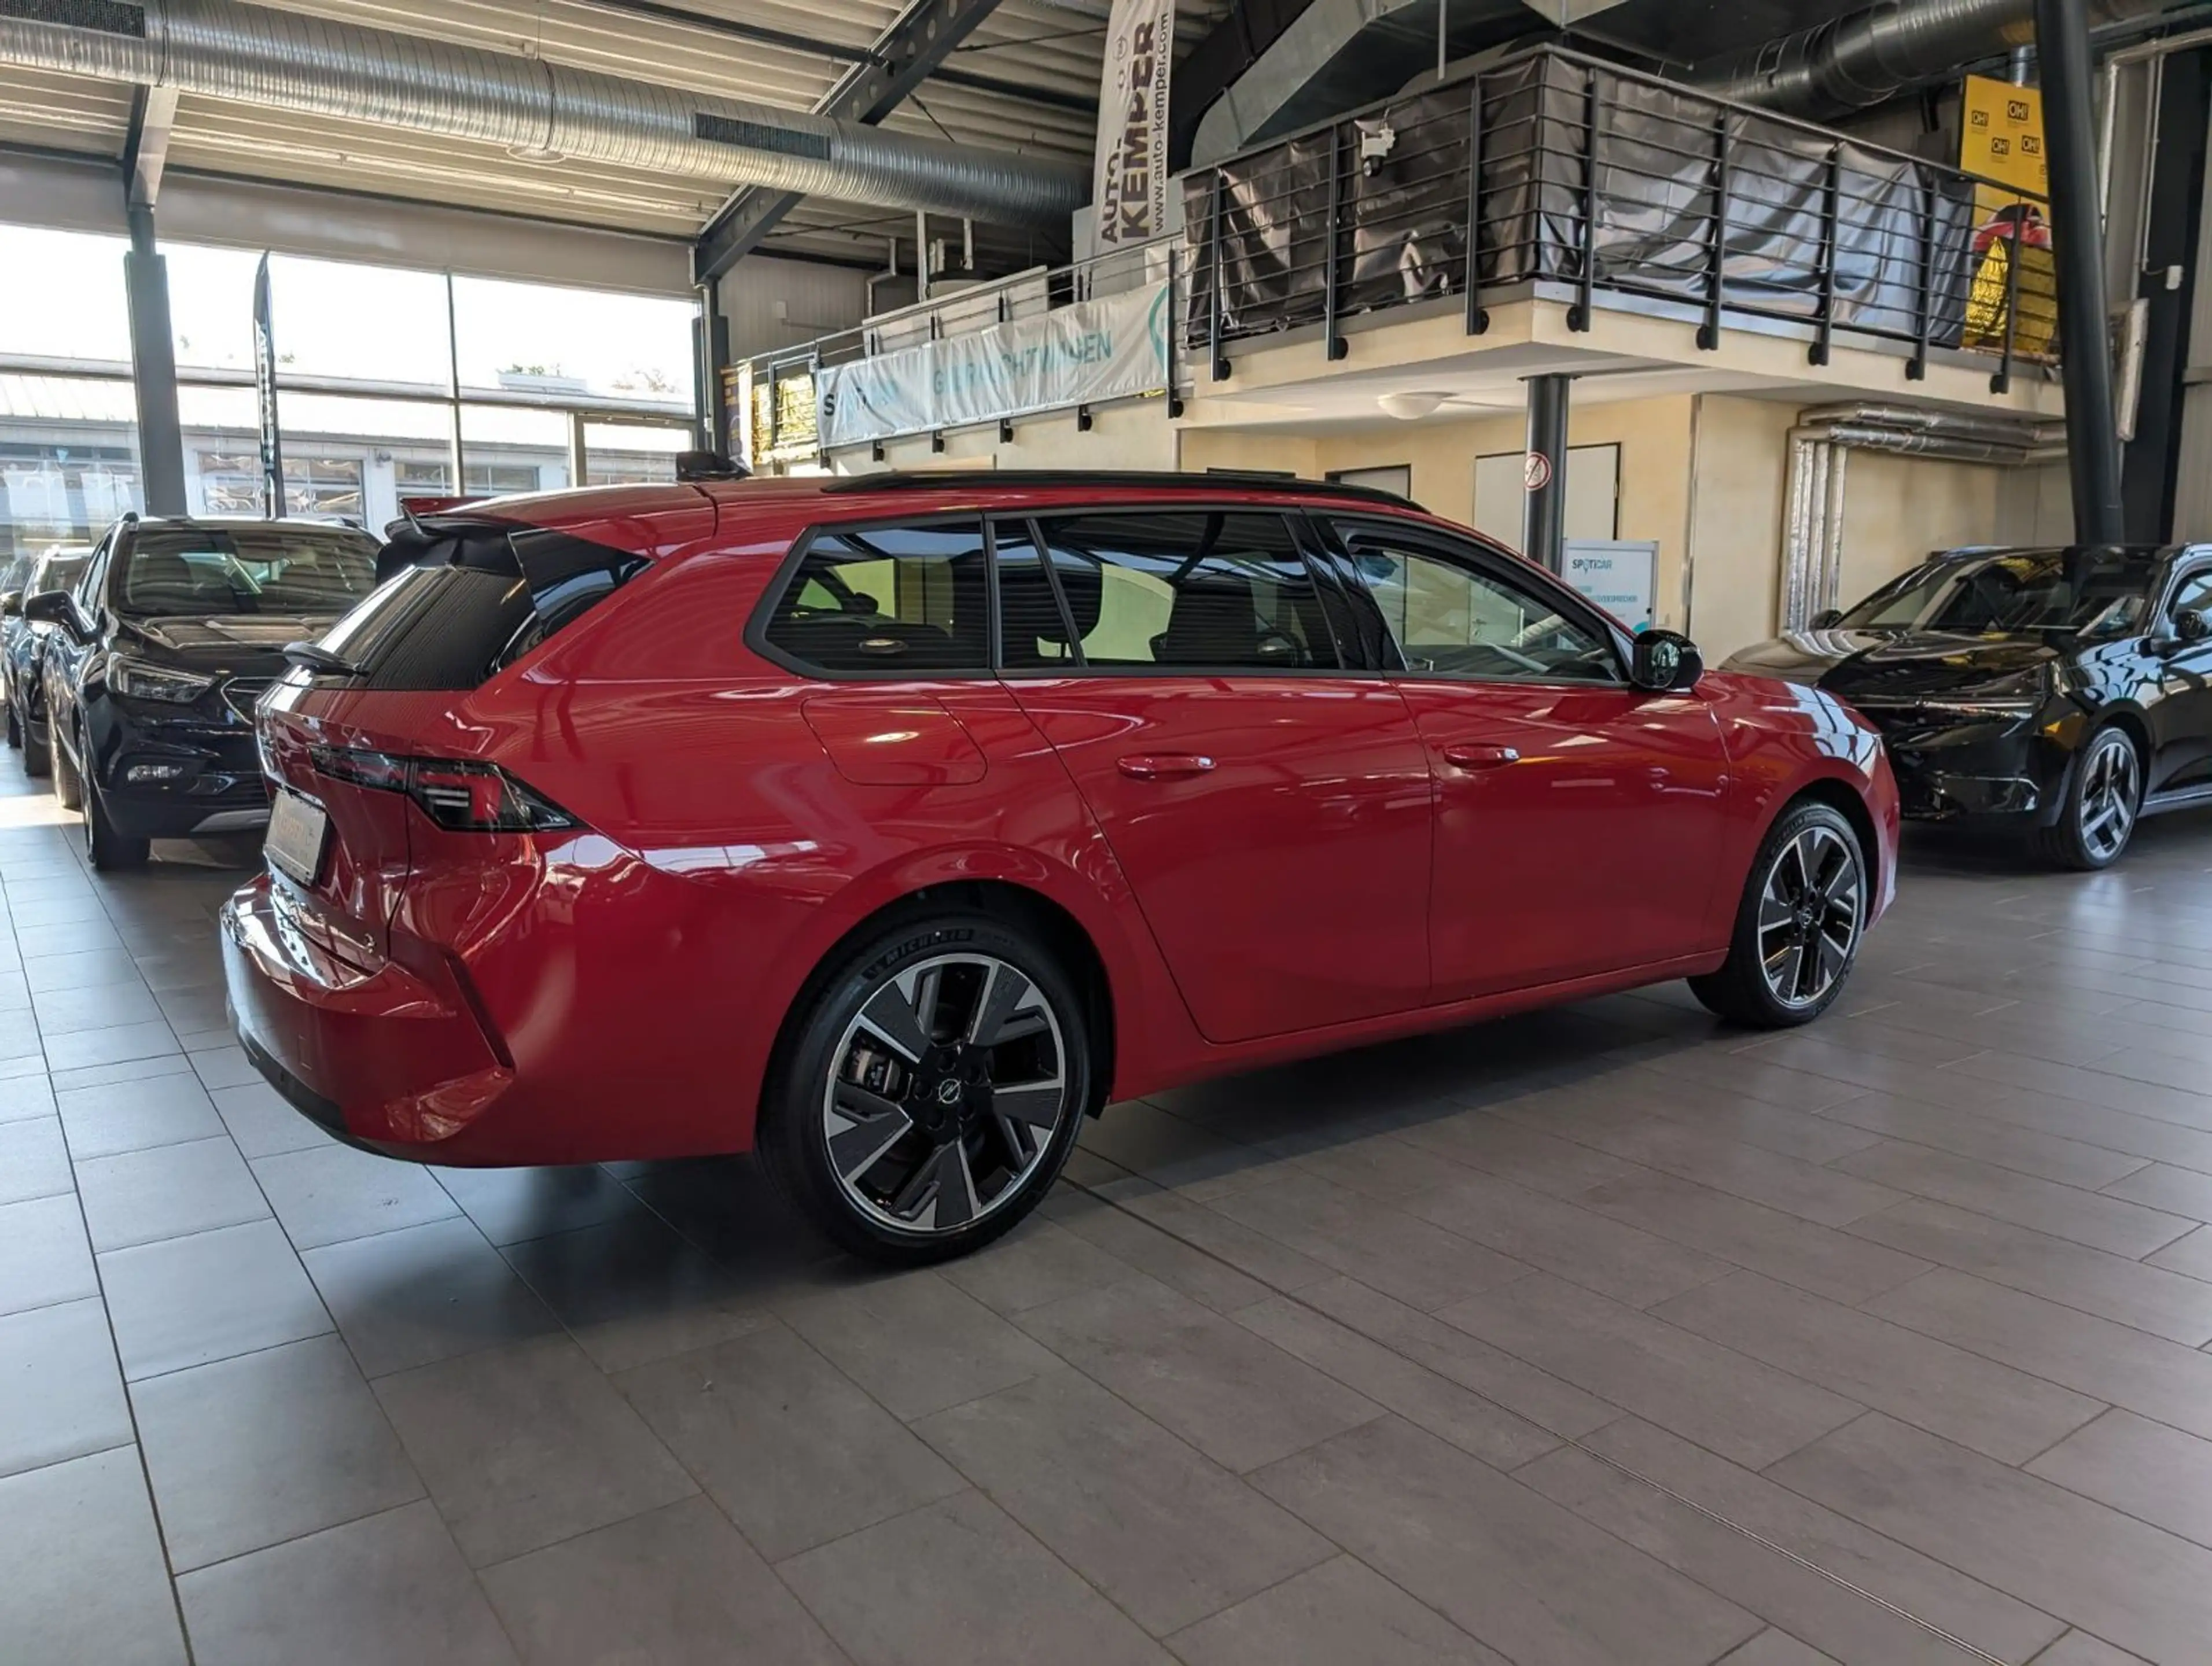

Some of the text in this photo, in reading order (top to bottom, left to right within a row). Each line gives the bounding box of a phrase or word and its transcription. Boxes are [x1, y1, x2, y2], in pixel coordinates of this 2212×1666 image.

[1121, 21, 1155, 239] KEMPER
[1151, 12, 1169, 232] www.auto-kemper.com
[2008, 102, 2028, 120] OH!
[1992, 139, 2009, 154] OH!
[2023, 137, 2040, 153] OH!
[1101, 137, 1122, 244] AUTO-
